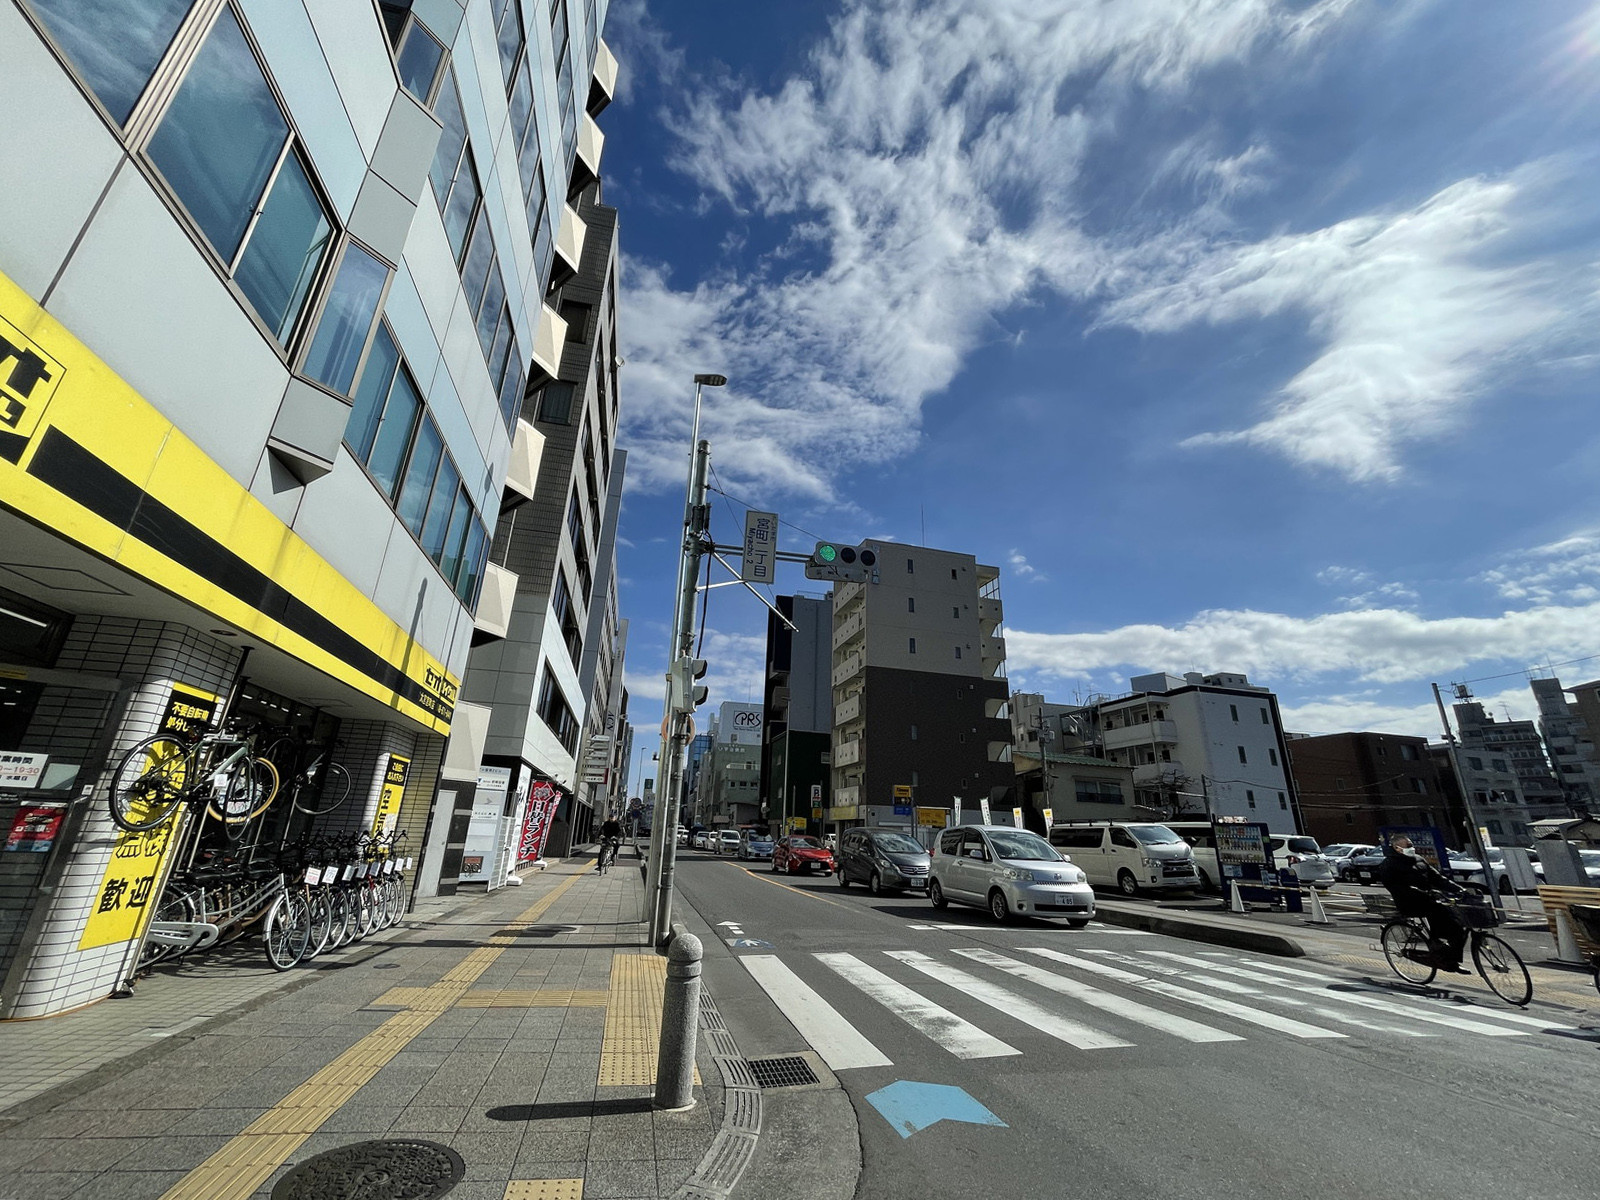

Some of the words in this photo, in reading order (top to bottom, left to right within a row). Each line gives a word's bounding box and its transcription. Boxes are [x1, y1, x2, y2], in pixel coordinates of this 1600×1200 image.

[747, 528, 756, 557] Miyacho
[754, 518, 770, 577] 宮町二丁目
[172, 702, 209, 721] 不要自転車
[0, 755, 33, 765] 業時間
[520, 800, 547, 858] 日替ランチ
[98, 876, 153, 914] 歓迎
